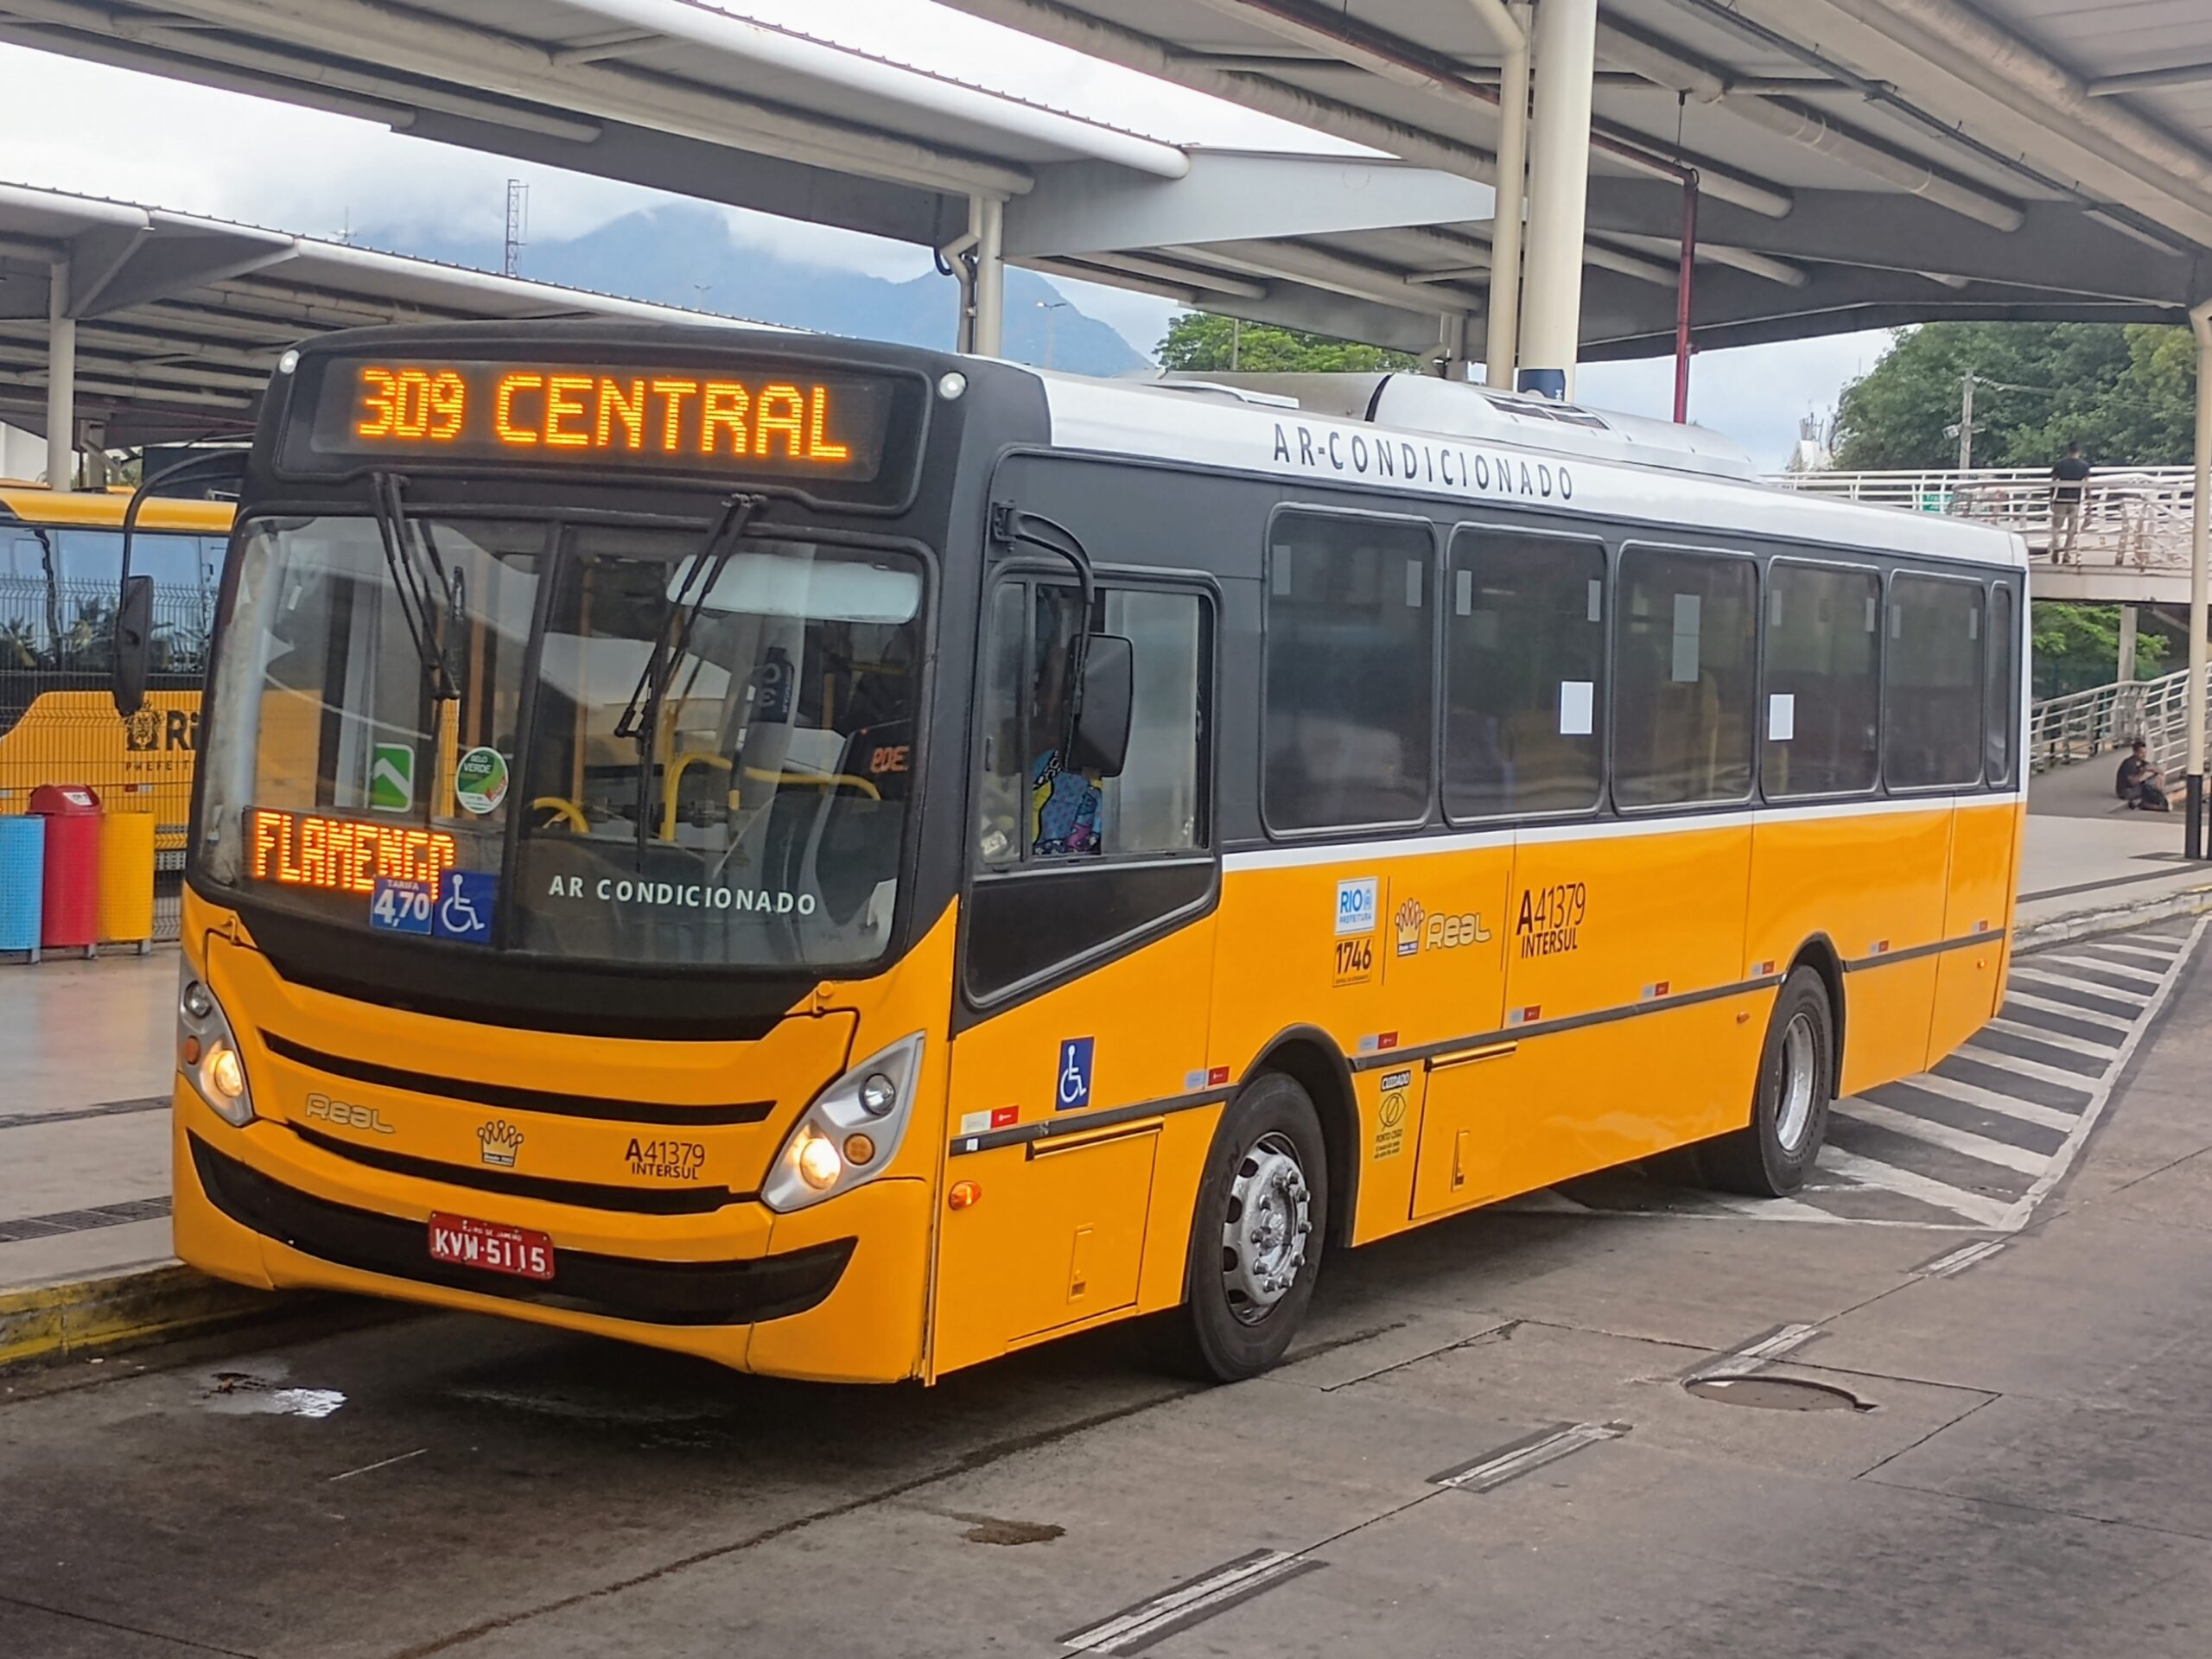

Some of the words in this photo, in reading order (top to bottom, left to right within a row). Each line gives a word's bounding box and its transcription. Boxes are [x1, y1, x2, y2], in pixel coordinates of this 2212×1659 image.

[359, 369, 465, 438] 309
[495, 374, 849, 458] CENTRAL
[1273, 423, 1573, 500] AR-CONDICIONADO
[463, 762, 493, 774] VERDE
[548, 874, 584, 899] AR
[595, 879, 817, 916] CONDICIONADO
[1340, 888, 1363, 914] RIO
[1516, 881, 1586, 936] A41379
[1336, 938, 1372, 975] 1746
[1521, 926, 1579, 960] INTERSUL
[624, 1137, 706, 1168] A41379
[631, 1161, 700, 1181] INTERSUL
